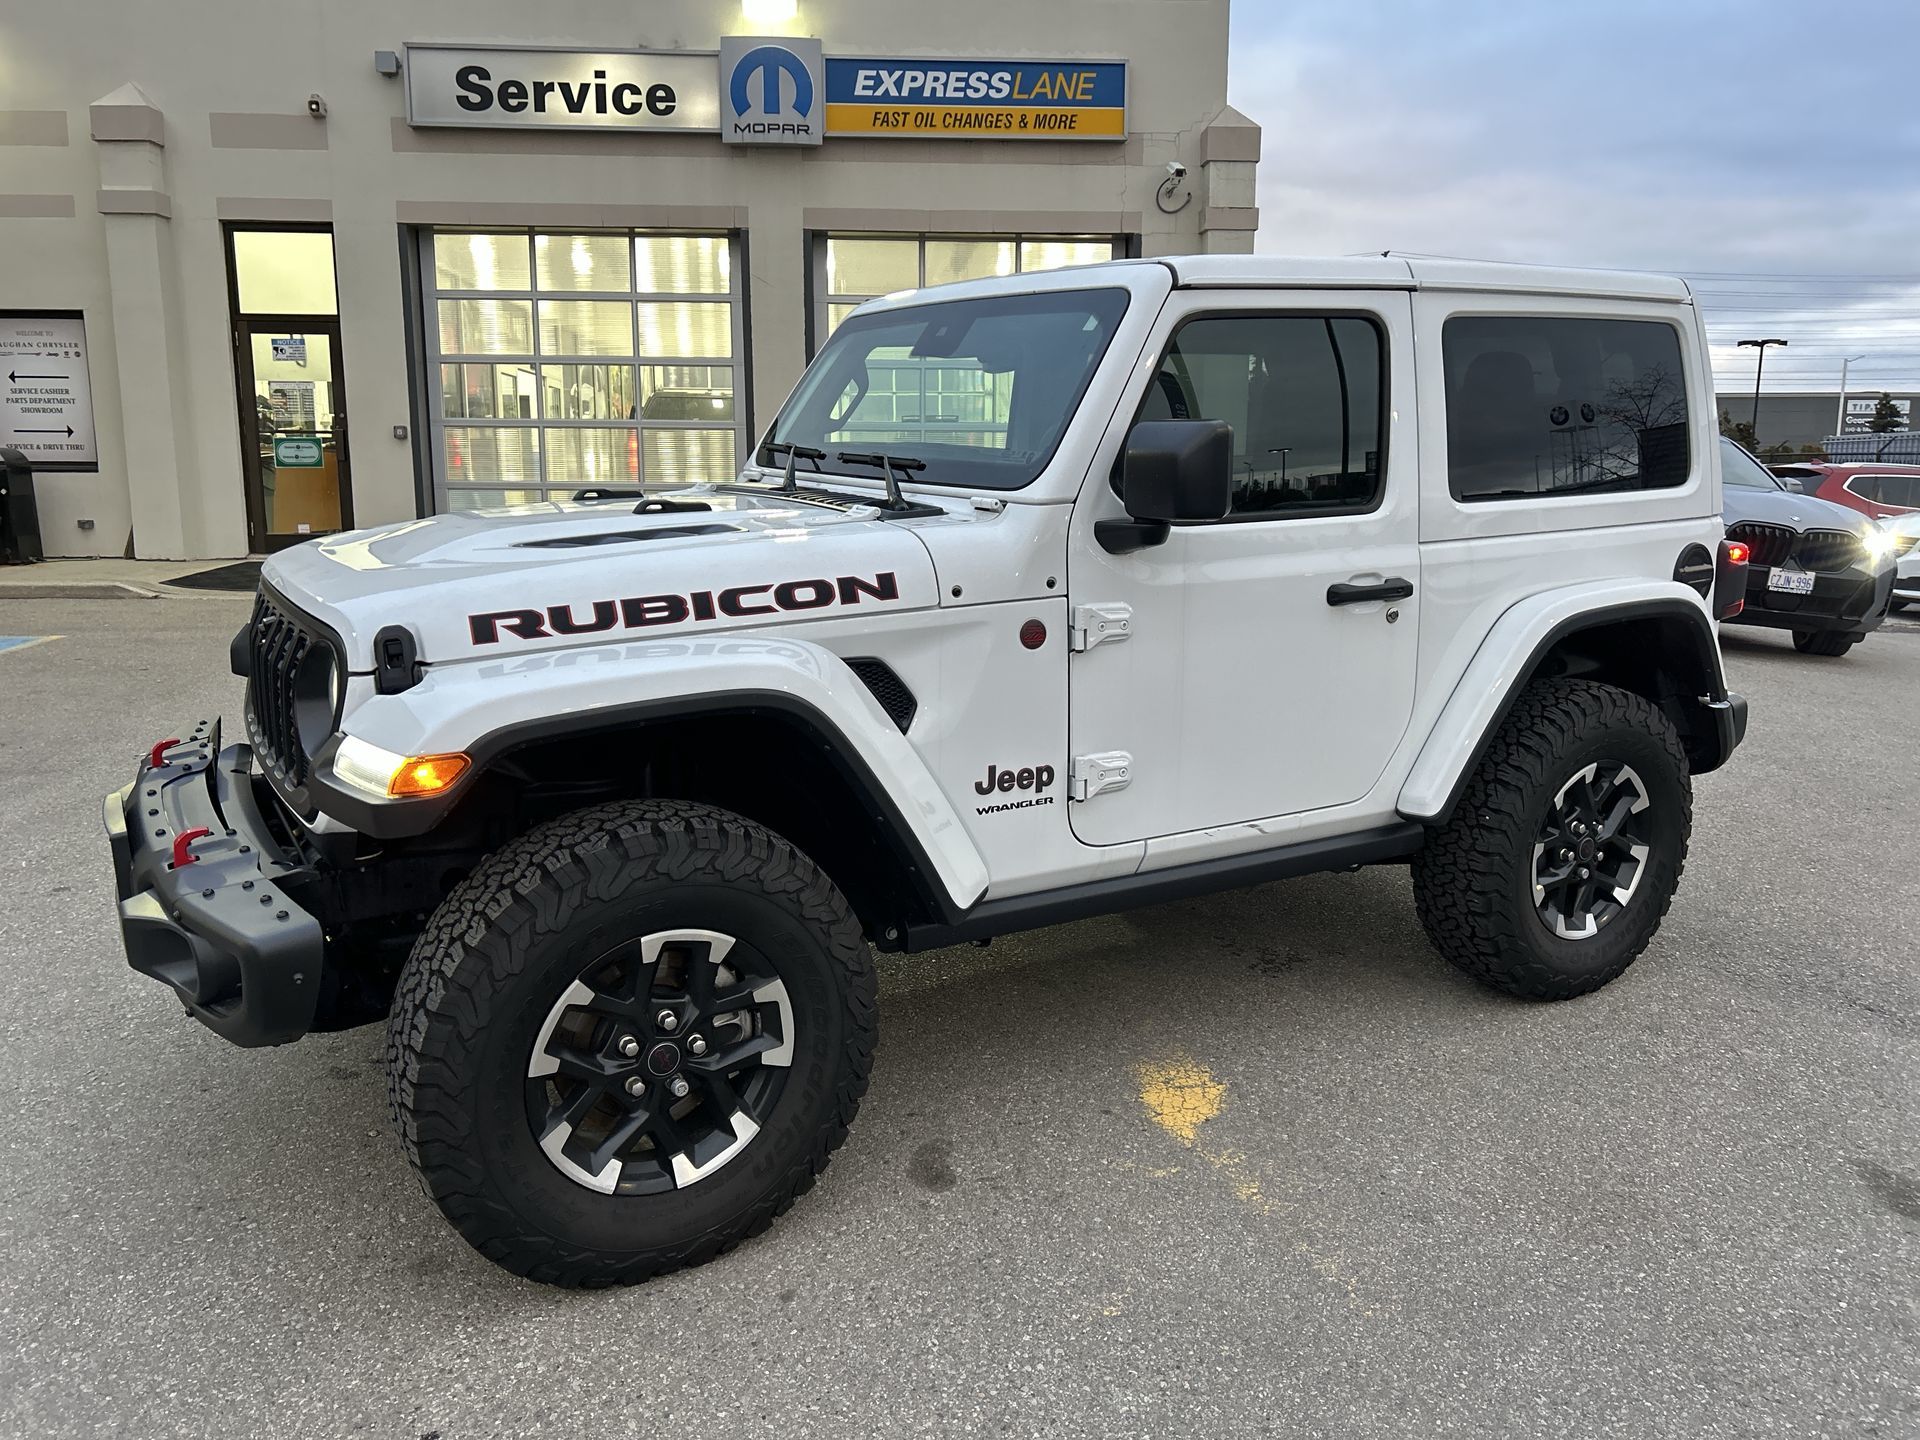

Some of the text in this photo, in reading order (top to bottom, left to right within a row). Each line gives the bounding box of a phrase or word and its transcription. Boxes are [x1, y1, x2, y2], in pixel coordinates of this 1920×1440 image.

[455, 65, 677, 117] Service
[872, 111, 1078, 130] FAST OIL CHANGES & MORE
[734, 123, 811, 135] MOPAR
[36, 341, 79, 349] CHRYSLER
[10, 387, 70, 395] SERVICE CASHIER
[29, 397, 76, 405] DEPARTMENT
[20, 406, 63, 414] SHOWROOM
[43, 443, 64, 451] DRIVE
[66, 443, 85, 451] THRU
[1770, 574, 1812, 589] CZJN 996
[468, 571, 899, 645] RUBICON
[975, 764, 1055, 795] Jeep
[976, 796, 1054, 816] WRANGLER
